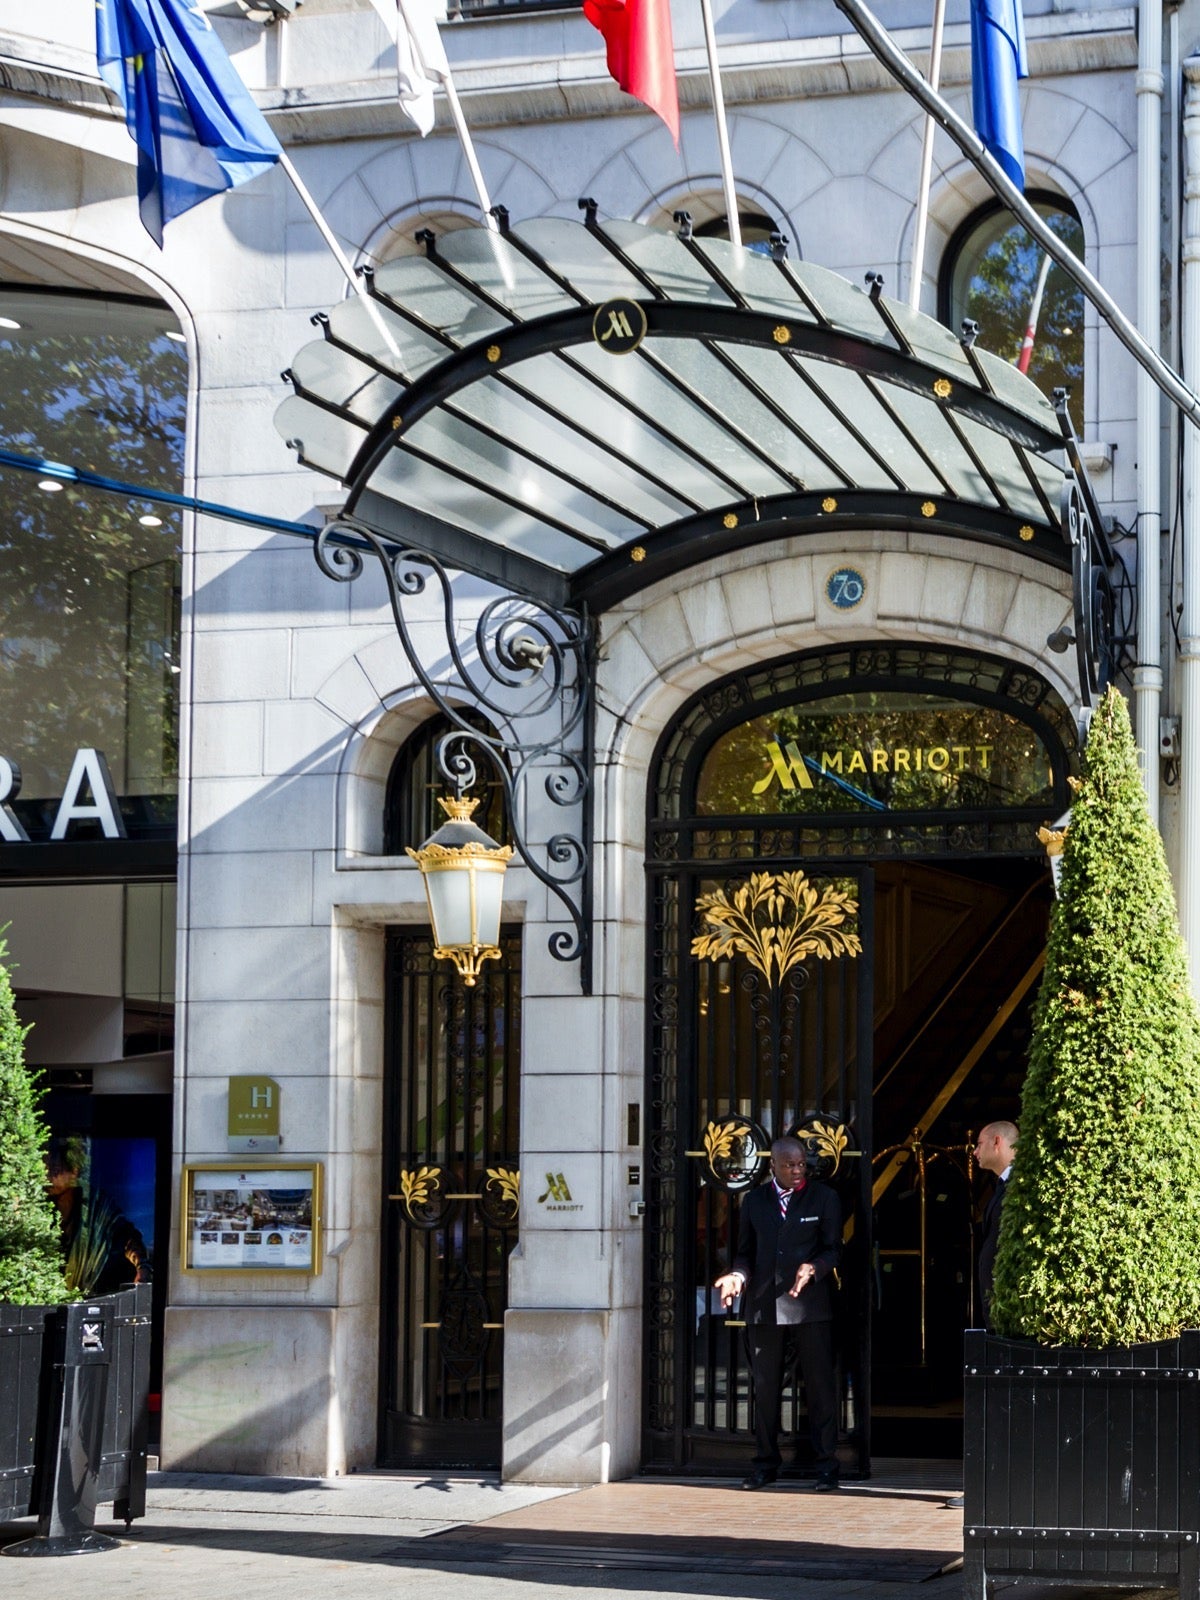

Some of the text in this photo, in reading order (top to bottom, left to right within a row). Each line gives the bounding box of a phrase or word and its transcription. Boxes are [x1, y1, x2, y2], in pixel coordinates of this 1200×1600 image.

[832, 574, 863, 603] 70
[820, 745, 994, 775] MARRIOTT
[251, 1086, 273, 1109] H
[546, 1204, 584, 1212] MARRIOTT
